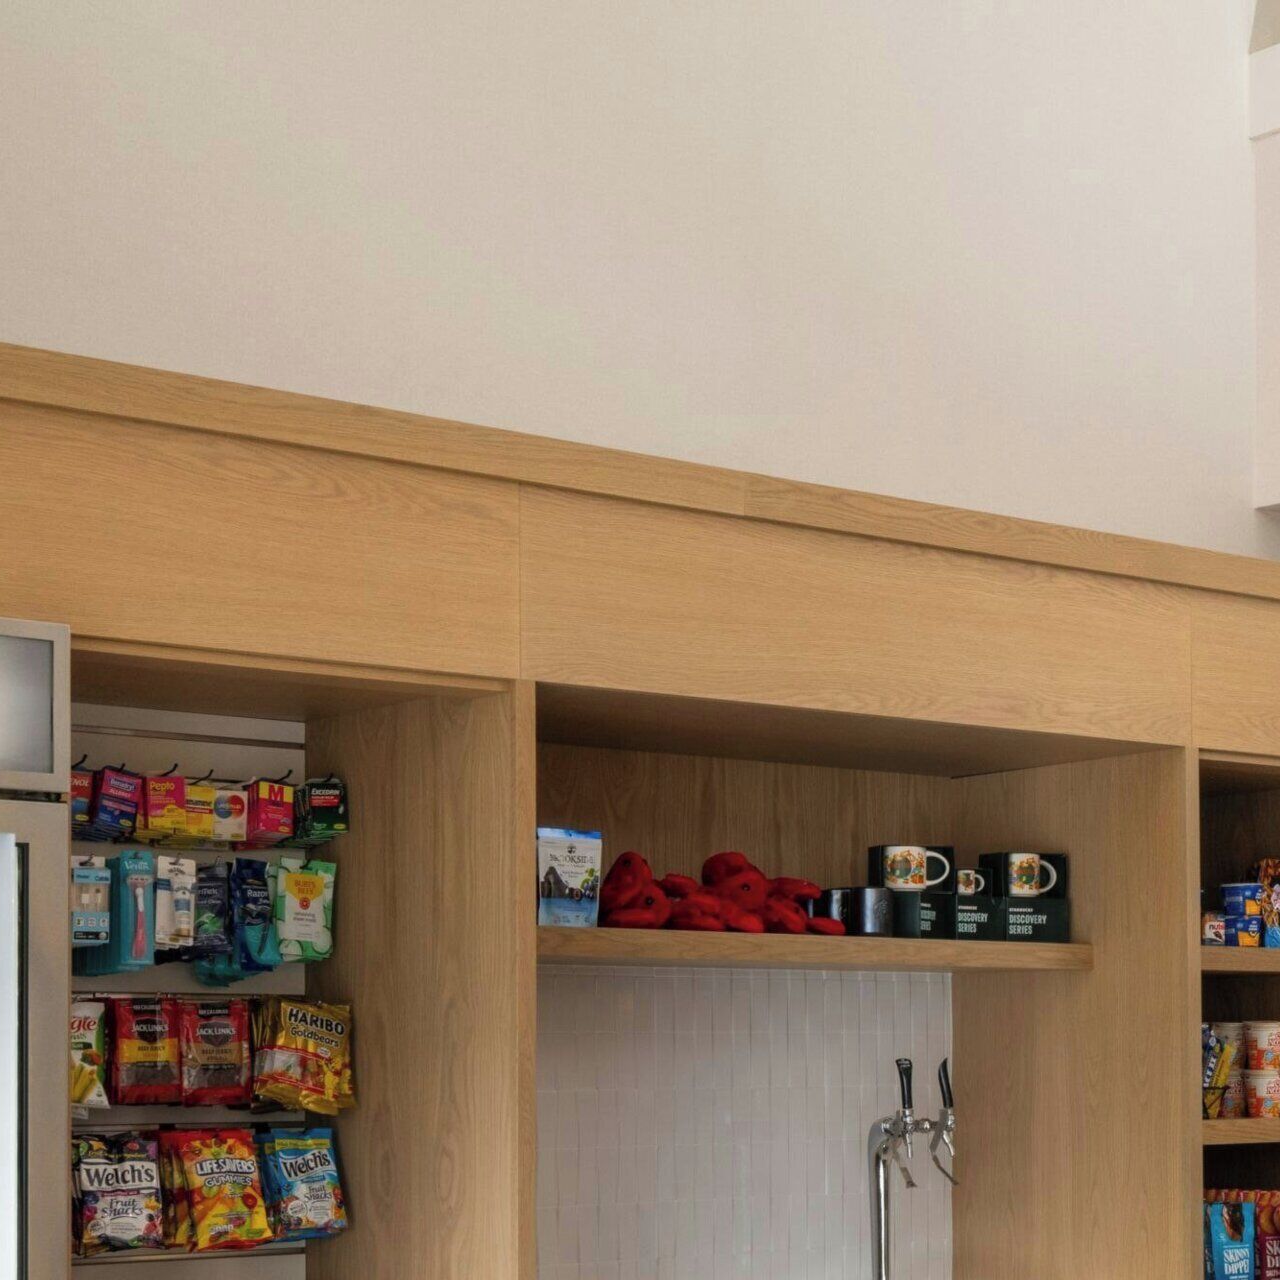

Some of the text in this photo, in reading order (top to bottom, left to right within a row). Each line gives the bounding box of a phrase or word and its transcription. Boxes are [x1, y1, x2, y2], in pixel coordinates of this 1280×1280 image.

[149, 781, 175, 791] Pepto
[957, 912, 988, 923] DISCOVERY
[1008, 914, 1047, 925] DISCOVERY
[957, 922, 977, 933] SERIES
[1008, 925, 1033, 935] SERIES
[287, 1007, 345, 1036] HARIBO
[290, 1026, 340, 1048] Goldbears
[281, 1151, 331, 1178] Welch's
[84, 1164, 156, 1187] Welch's
[204, 1174, 253, 1187] GUMMIES
[303, 1190, 333, 1201] Snacks
[307, 1185, 326, 1195] Fruit
[109, 1198, 138, 1209] Fruit
[101, 1206, 144, 1219] Snacks
[1223, 1248, 1250, 1263] SKINNY
